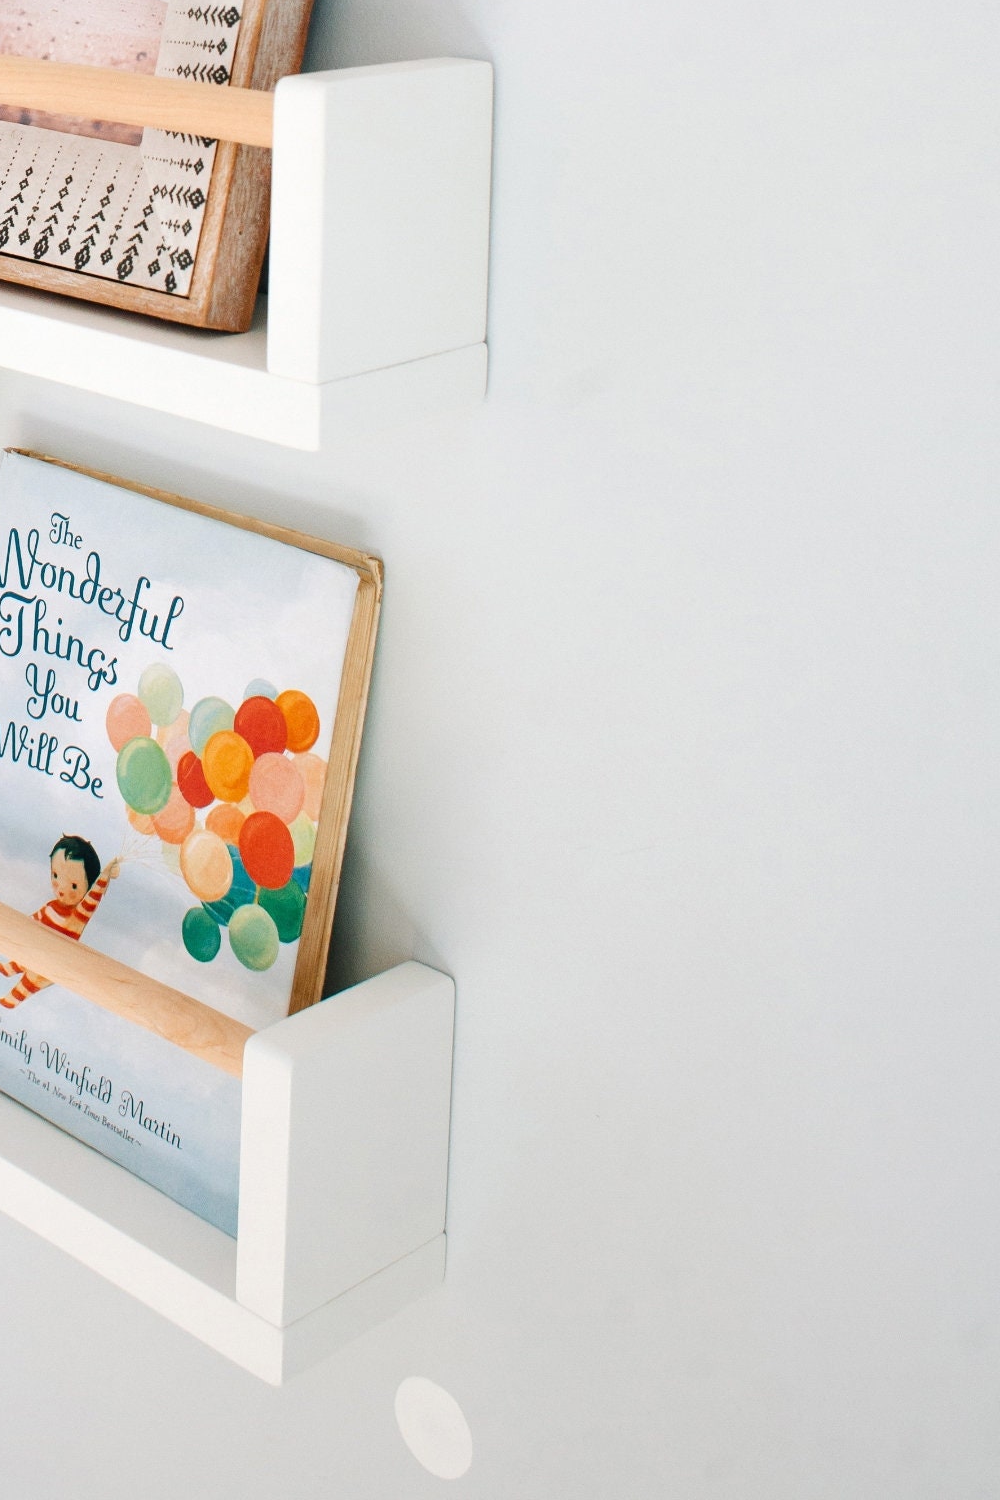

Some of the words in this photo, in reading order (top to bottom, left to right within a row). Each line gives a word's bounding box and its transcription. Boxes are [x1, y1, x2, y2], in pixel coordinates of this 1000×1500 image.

[49, 511, 84, 551] The
[25, 662, 83, 723] You
[60, 745, 105, 799] Be
[39, 1040, 113, 1105] Winfield
[118, 1090, 183, 1151] Martin
[52, 1085, 67, 1101] New
[68, 1094, 82, 1112] York
